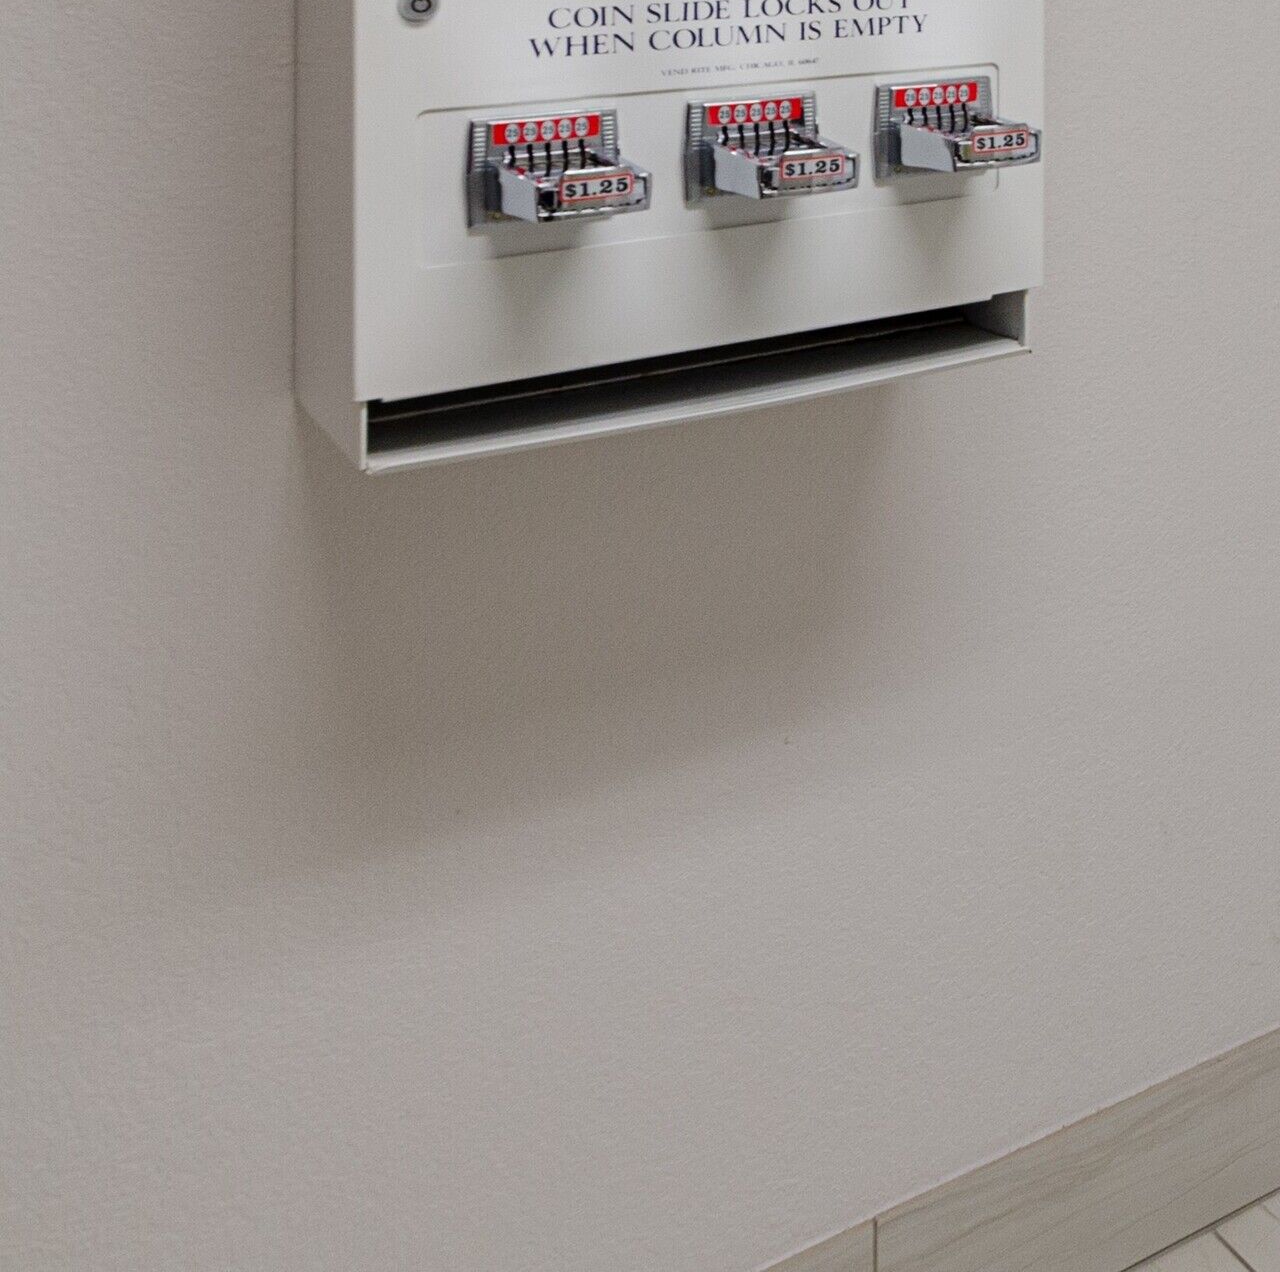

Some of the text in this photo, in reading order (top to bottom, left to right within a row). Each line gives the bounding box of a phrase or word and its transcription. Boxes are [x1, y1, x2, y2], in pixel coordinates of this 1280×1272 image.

[548, 5, 634, 29] COIN
[646, 0, 731, 24] SLIDE
[528, 14, 928, 58] WHEN COLUMN IS EMPTY
[976, 133, 1026, 150] $1.25
[785, 159, 840, 176] $1.25
[565, 178, 628, 197] $1.25
